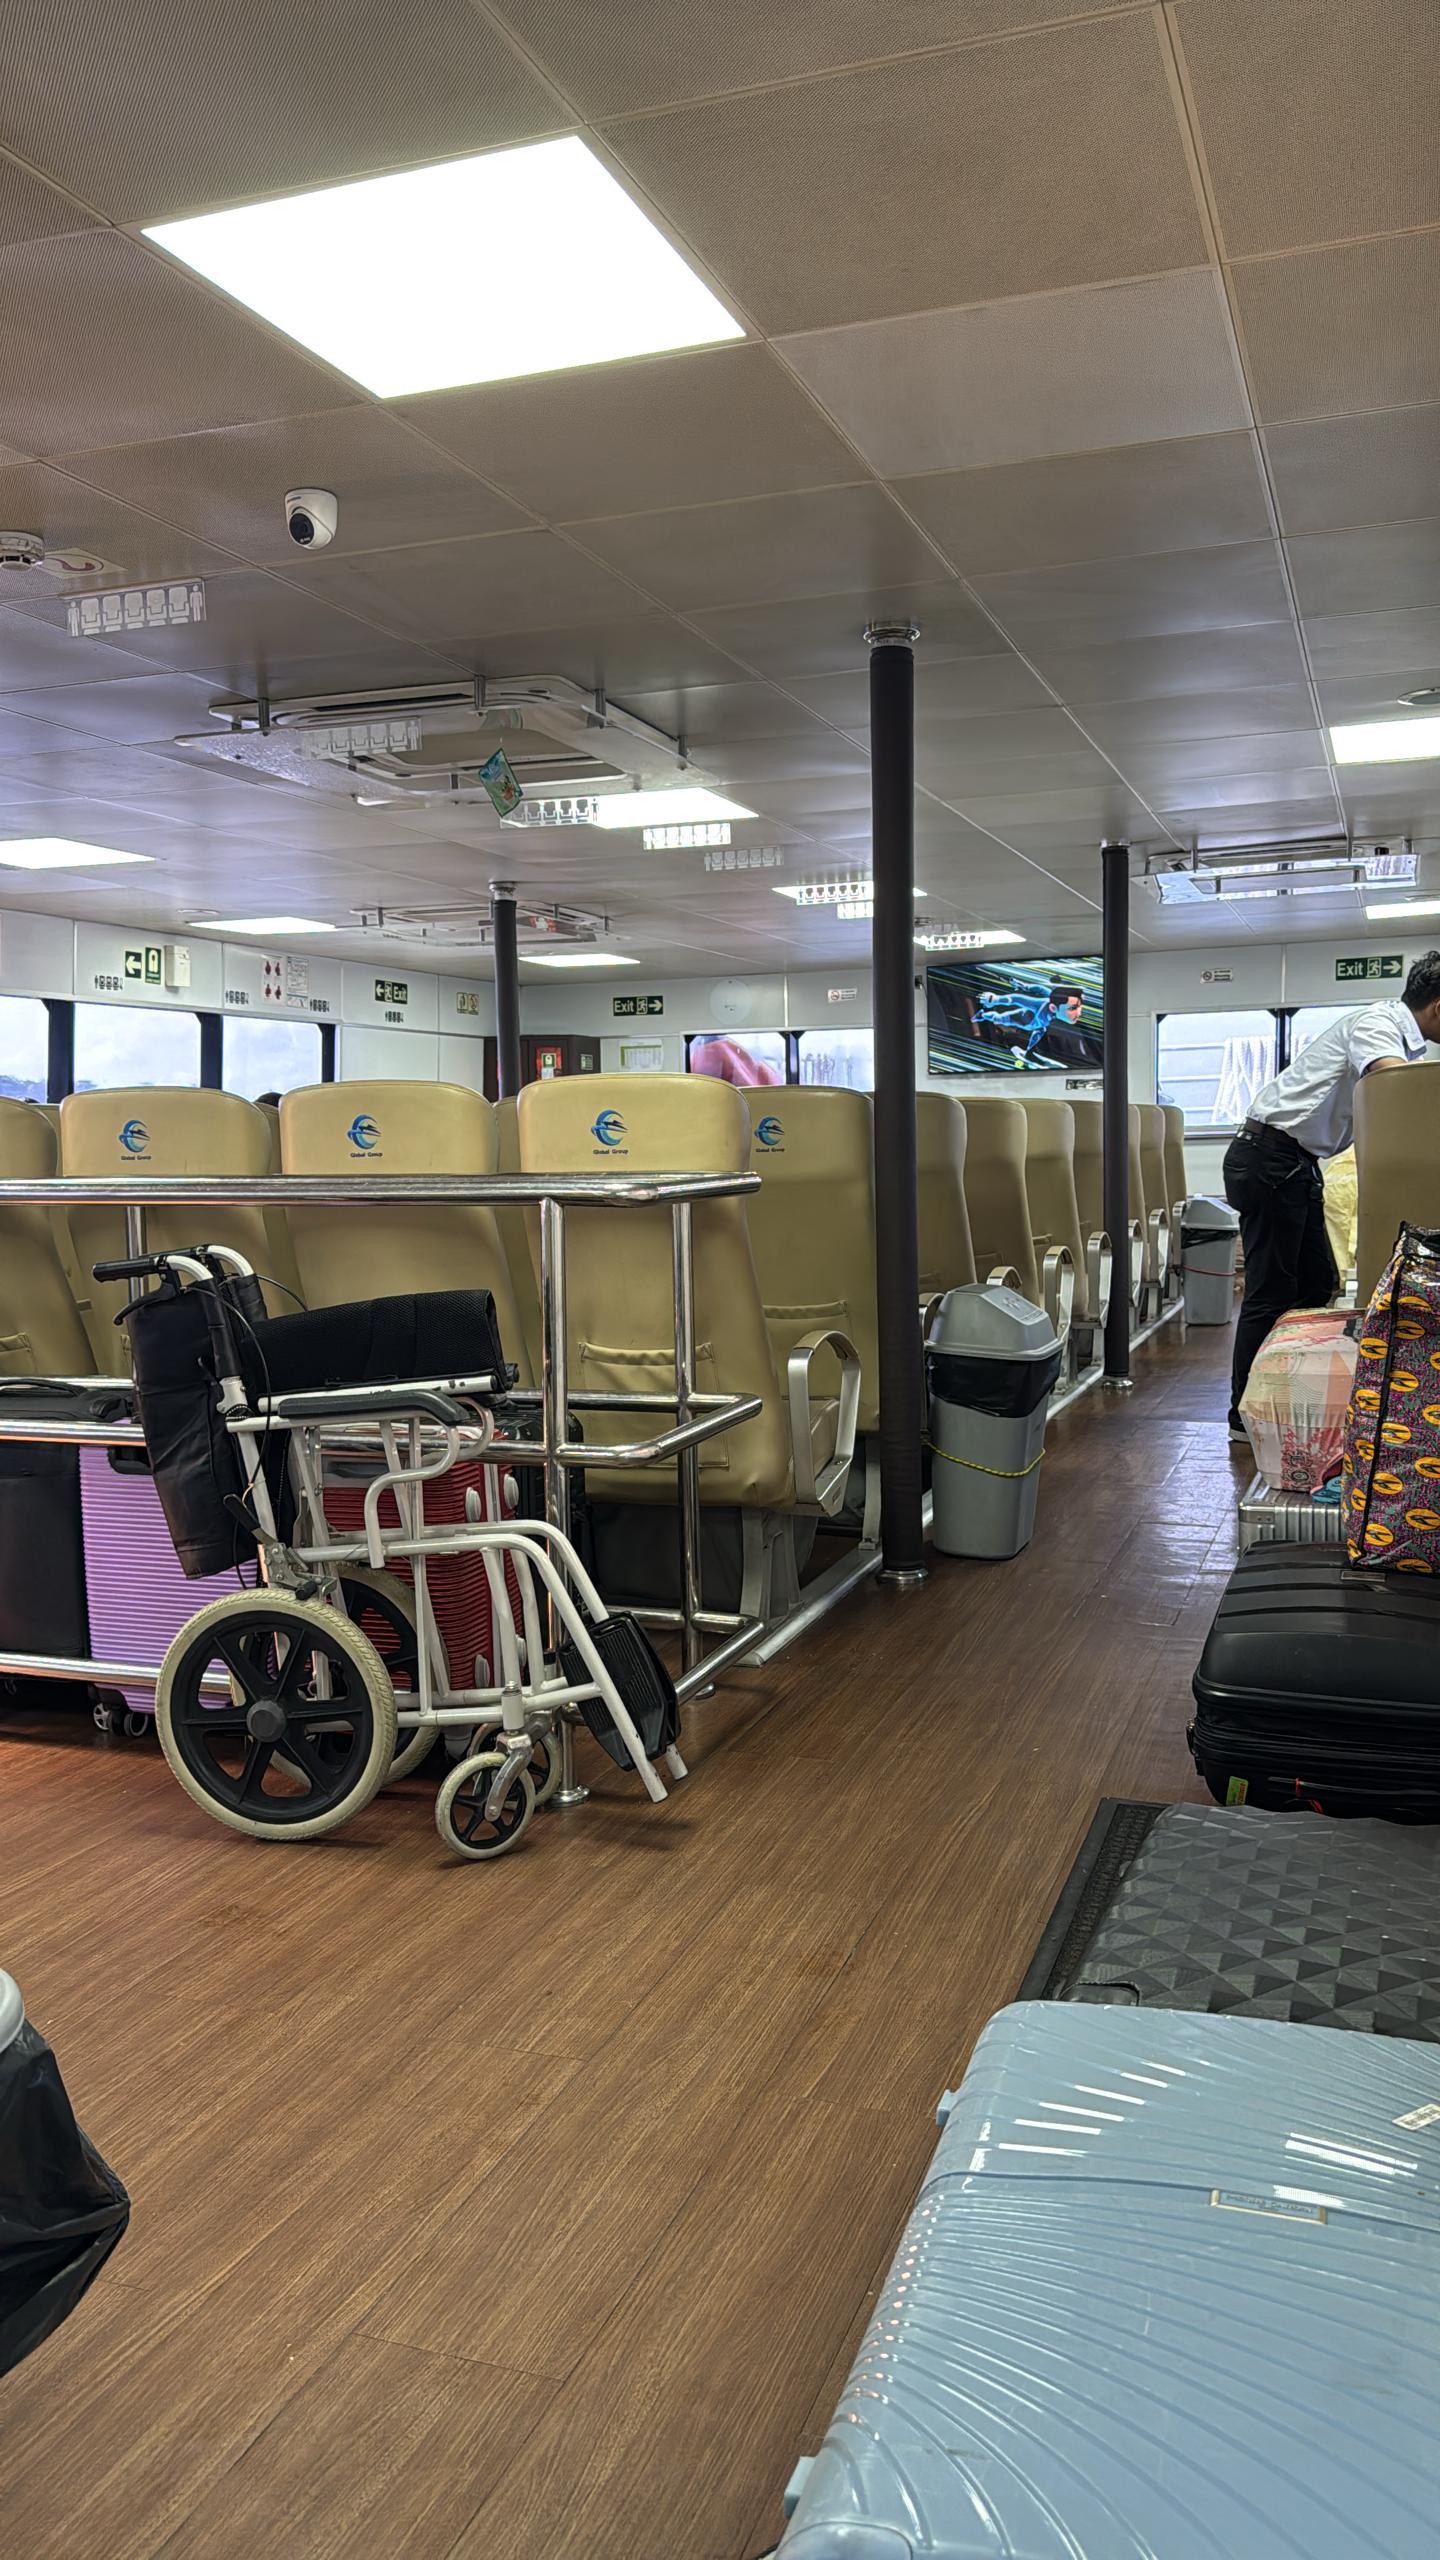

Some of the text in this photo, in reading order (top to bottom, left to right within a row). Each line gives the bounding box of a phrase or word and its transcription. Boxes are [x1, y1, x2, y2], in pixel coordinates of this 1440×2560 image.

[1337, 961, 1363, 976] Exit
[393, 985, 407, 1001] Exit
[614, 1000, 635, 1013] Exit
